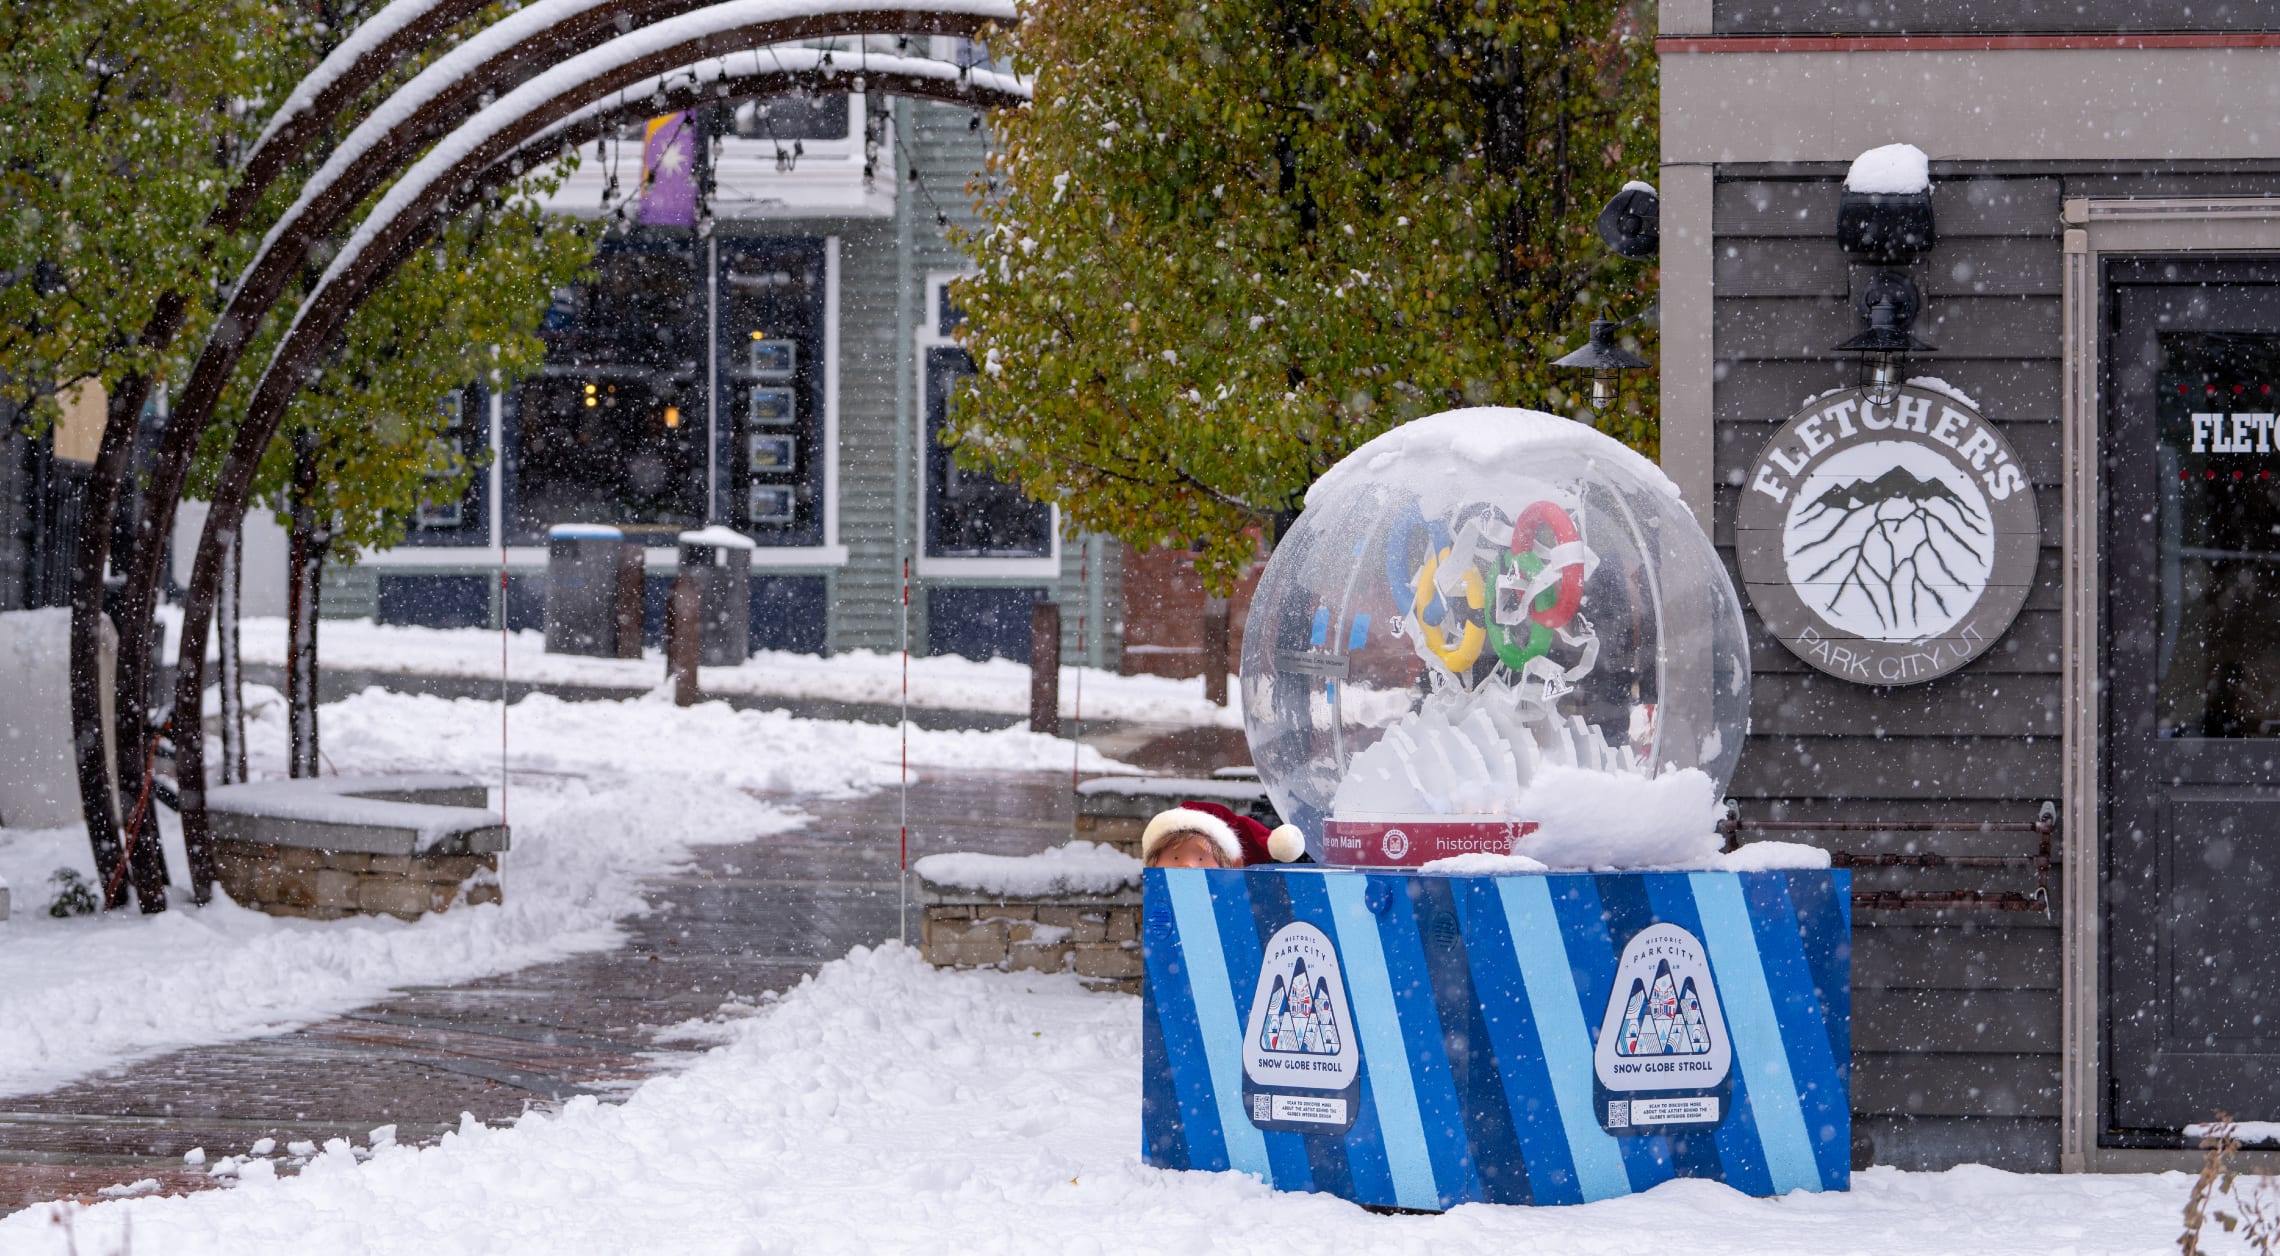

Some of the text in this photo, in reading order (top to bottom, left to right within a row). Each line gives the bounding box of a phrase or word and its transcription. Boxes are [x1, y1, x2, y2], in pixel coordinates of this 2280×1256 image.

[2191, 413, 2280, 454] FLET
[1752, 394, 2026, 503] FLETCHER'S
[1796, 621, 1986, 681] PARK CITY UT
[1330, 837, 1339, 848] on
[1340, 835, 1362, 849] Main
[1285, 935, 1316, 943] HISTORIC
[1645, 936, 1682, 945] HISTORIC
[1275, 945, 1326, 961] PARK CITY
[1633, 946, 1693, 963] PARK CITY
[1258, 1058, 1343, 1073] SNOW GLOBE STROLL
[1613, 1061, 1713, 1074] SNOW GLOBE STROLL
